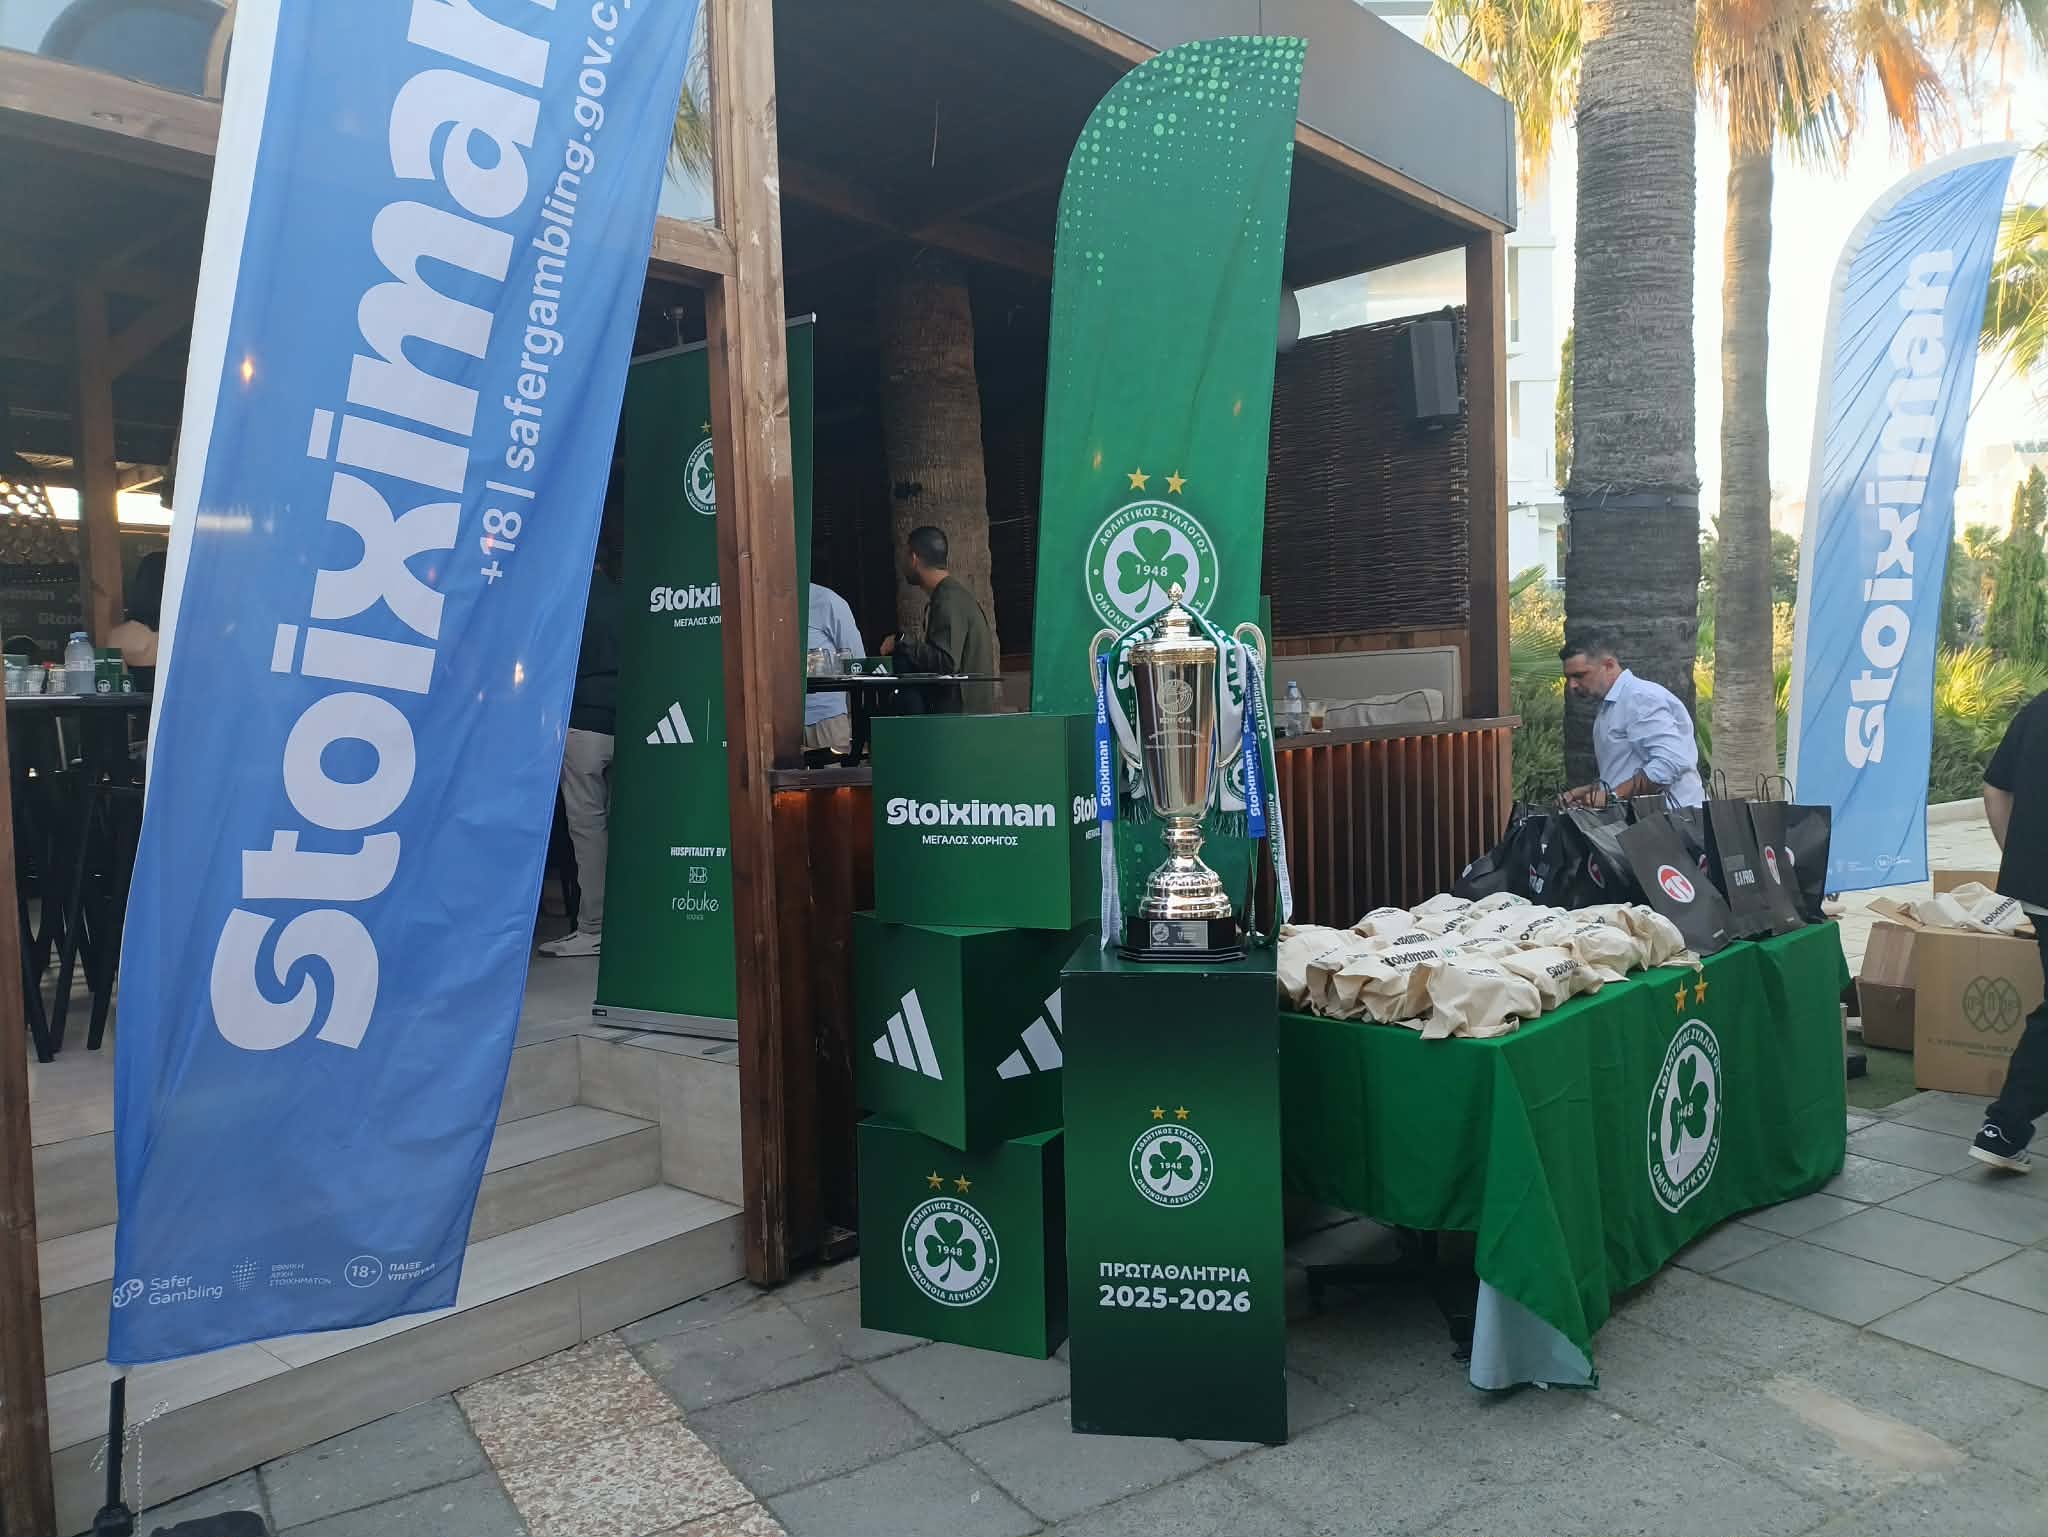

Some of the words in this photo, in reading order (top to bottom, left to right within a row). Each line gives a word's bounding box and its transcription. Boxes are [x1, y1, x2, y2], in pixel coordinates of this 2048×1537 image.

[480, 508, 521, 584] +18
[504, 0, 630, 472] safergambling.gov.c
[1845, 248, 1953, 769] Stoiximan
[1100, 507, 1158, 547] ΑΘΛΗΤΙΚΟΣ
[1161, 509, 1209, 556] ΣΥΛΛΟΓΟΣ
[1135, 564, 1168, 577] 1948
[674, 616, 708, 627] ΜΕΓΑΛΟΣ
[1095, 592, 1131, 630] ΟΜΟΝΟ
[1100, 740, 1111, 807] Stoiximan
[1246, 749, 1261, 817] Stoiximan
[886, 798, 1056, 827] Stoiximan
[670, 847, 715, 856] HOSPITALITY
[716, 848, 726, 856] BY
[922, 834, 969, 845] ΜΕΓΑΛΟΣ
[971, 836, 1018, 846] ΧΟΡΗΓΟΣ
[672, 890, 719, 911] rebuke
[1137, 1128, 1172, 1153] ΑΘΛΗΤΙΚΟΣ
[1174, 1128, 1206, 1155] ΣΥΛΛΟΓΟΣ
[1137, 1178, 1168, 1203] ΟΜΟΝΟΙΑ
[1169, 1181, 1206, 1204] ΛΕΥΚΩΣΙΑΣ
[910, 1202, 951, 1230] ΑΘΛΗΤΙΚΟΣ
[954, 1205, 991, 1241] ΣΥΛΛΟΓΟΣ
[937, 1245, 963, 1256] 1948
[390, 1261, 423, 1271] ΠΑΙΞΕ
[1100, 1262, 1250, 1283] ΠΡΩΤΑΘΛΗΤΡΙΑ
[149, 1284, 223, 1305] Gambling
[150, 1275, 193, 1291] Safer
[911, 1264, 945, 1299] ΟΜΟΝΟΙΑ
[948, 1275, 991, 1301] ΛΕΥΚΩΣΙΑΣ
[1099, 1285, 1250, 1312] 2025-2026
